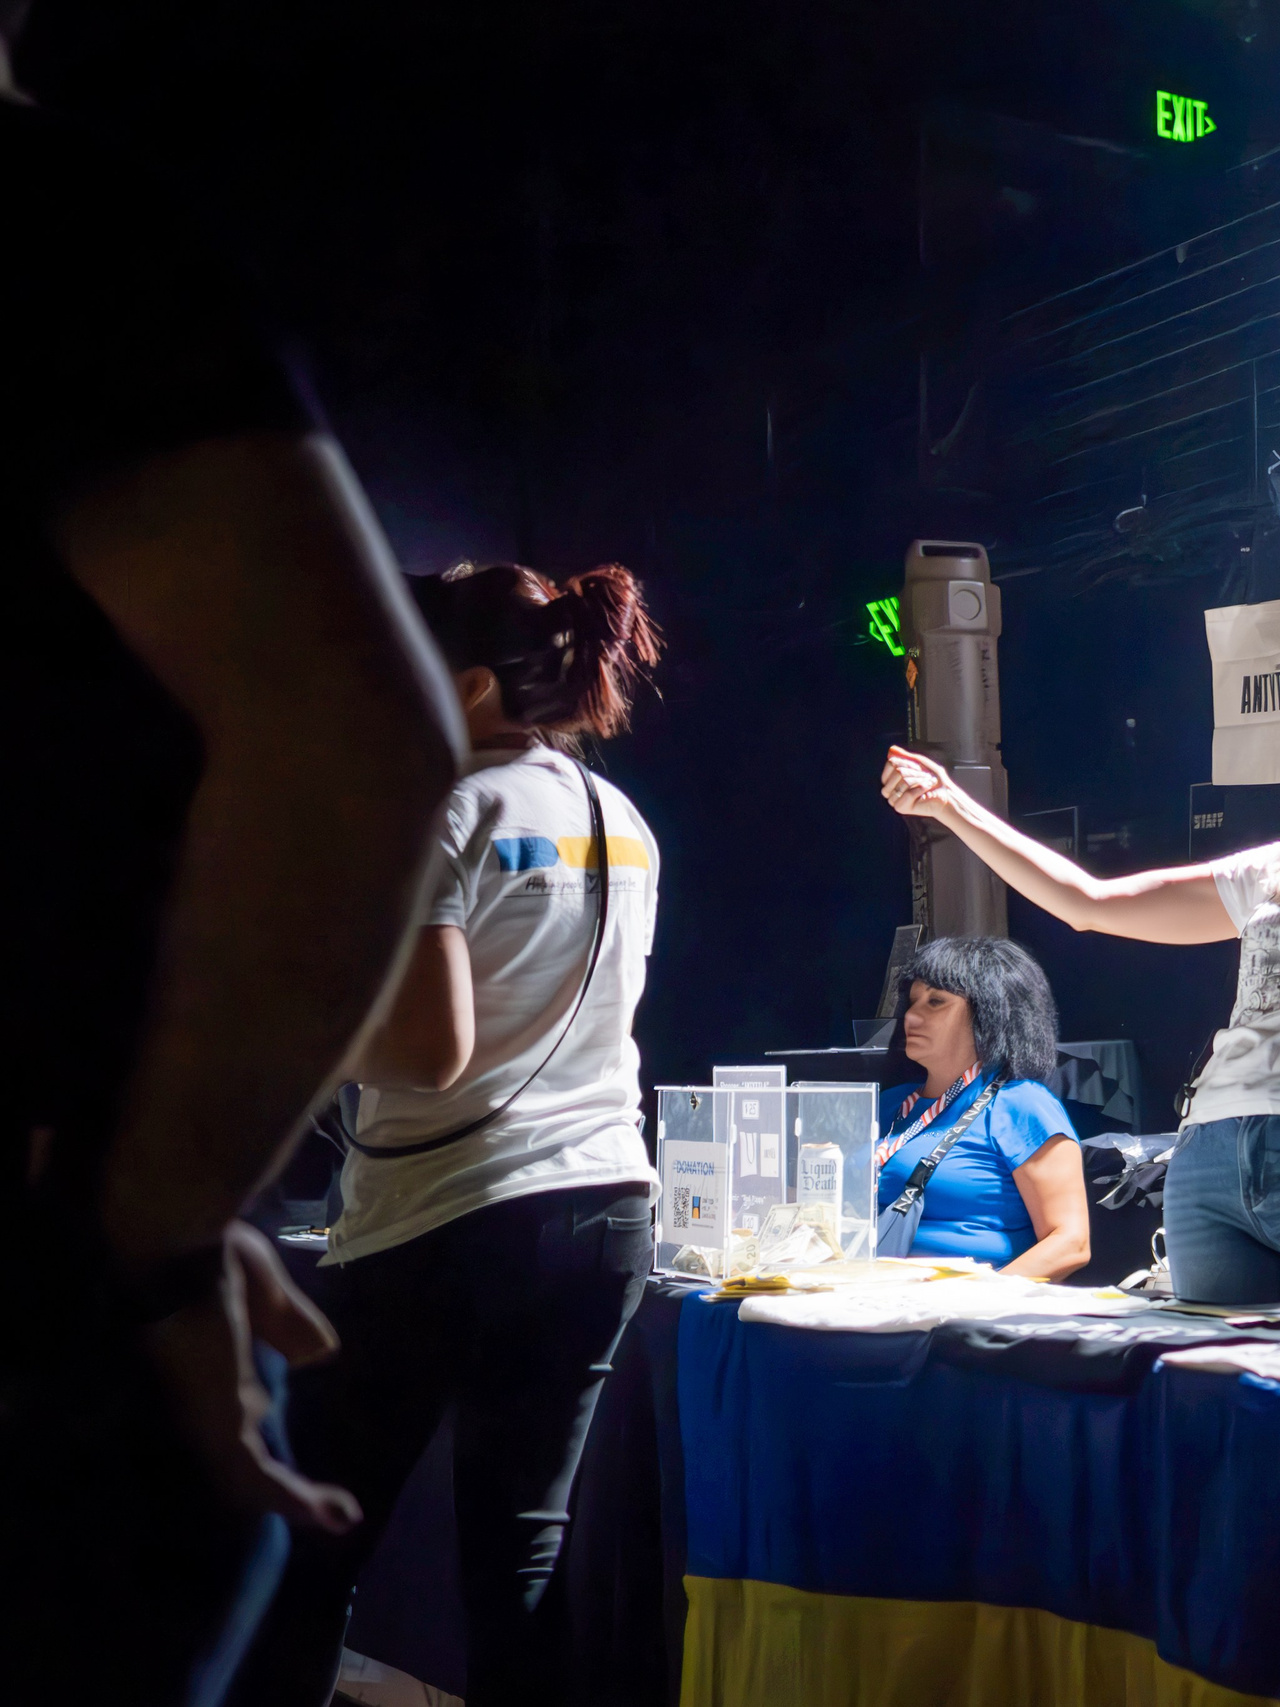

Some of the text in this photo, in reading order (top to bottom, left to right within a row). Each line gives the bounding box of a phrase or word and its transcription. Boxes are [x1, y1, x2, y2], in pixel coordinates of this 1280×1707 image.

[1156, 89, 1208, 143] EXIT
[676, 1160, 715, 1176] DONATION
[801, 1159, 837, 1179] Liquid
[803, 1176, 837, 1191] Death
[745, 1244, 757, 1260] 20
